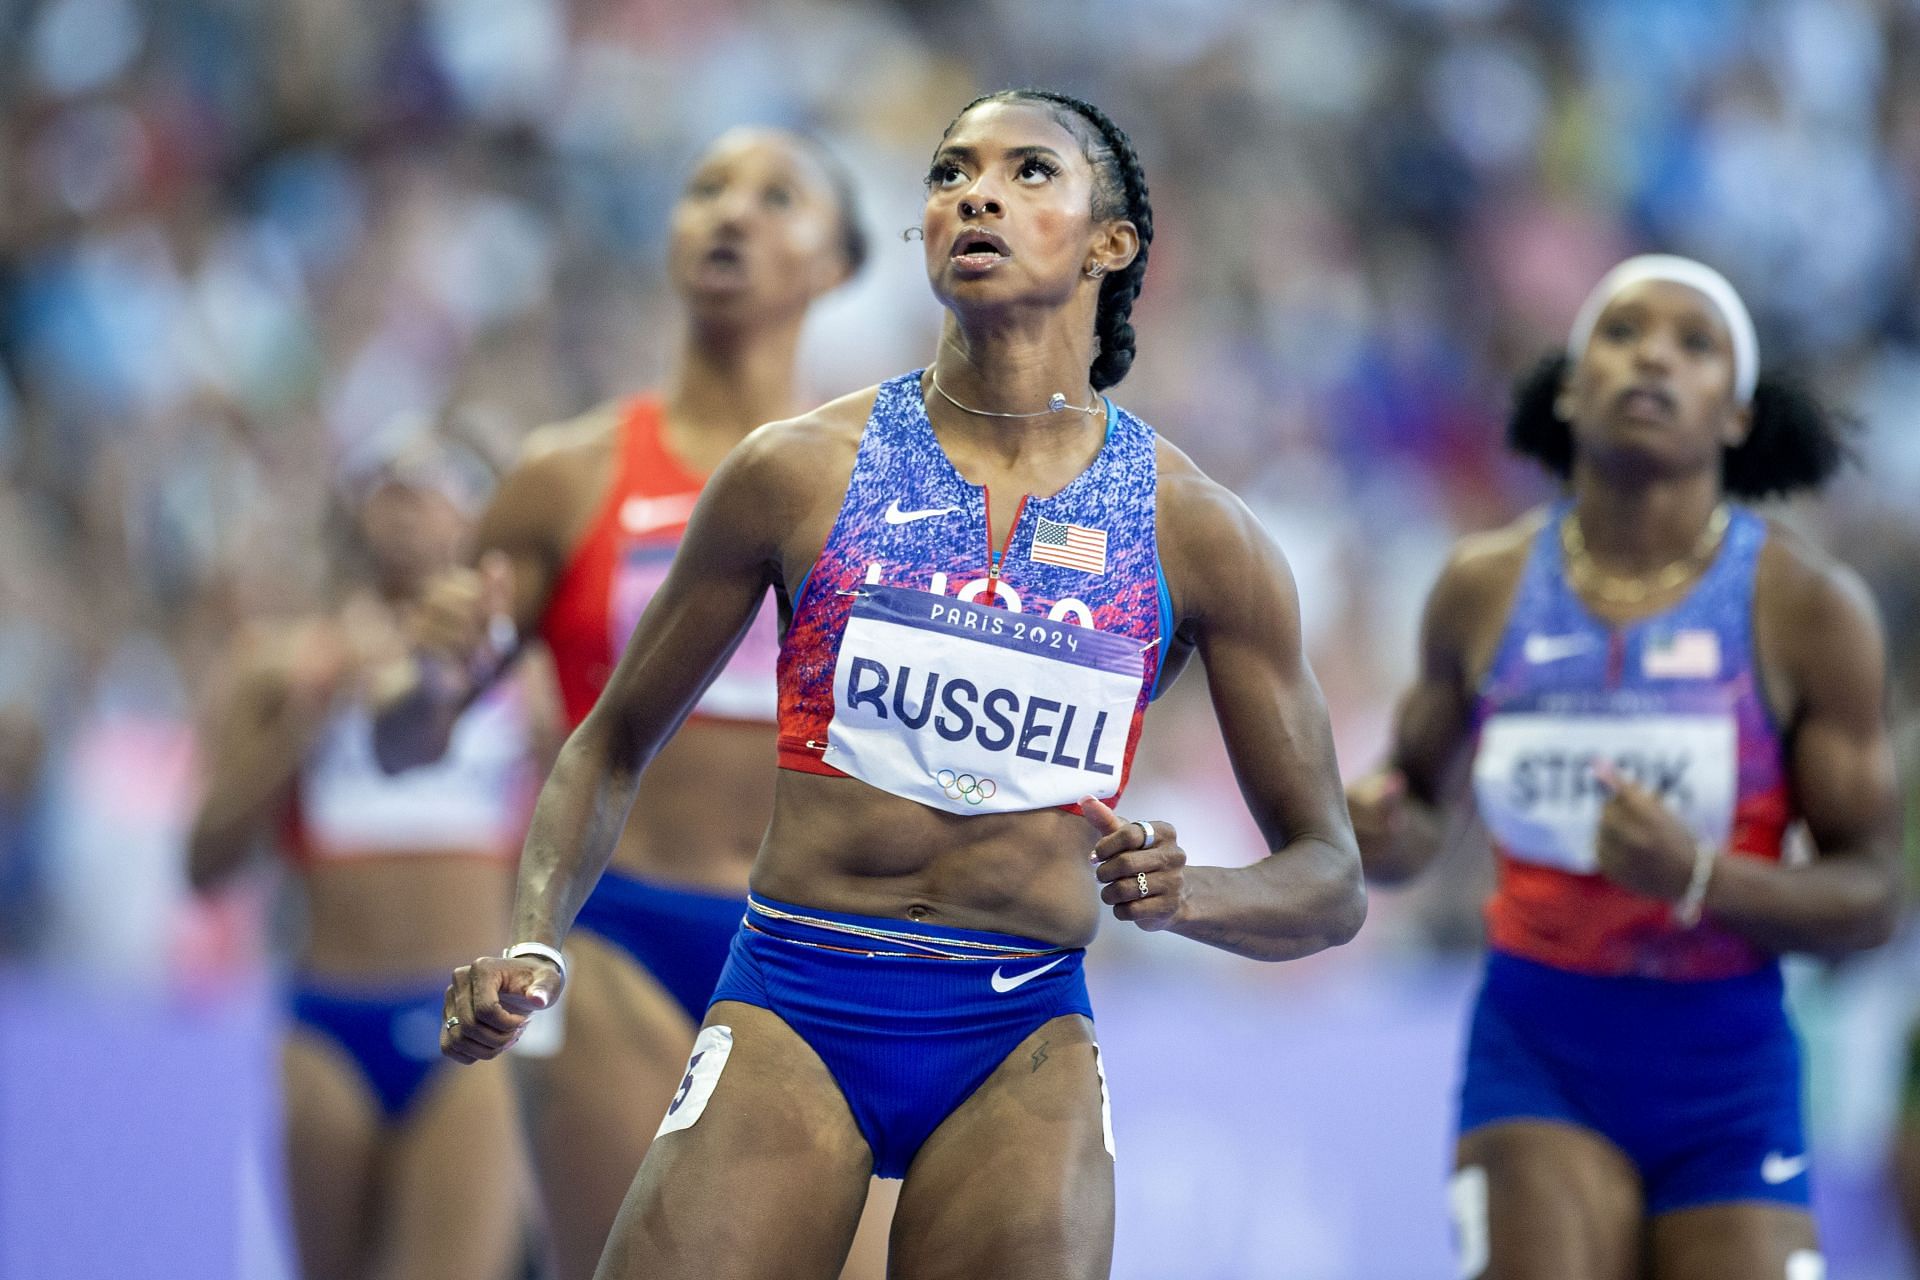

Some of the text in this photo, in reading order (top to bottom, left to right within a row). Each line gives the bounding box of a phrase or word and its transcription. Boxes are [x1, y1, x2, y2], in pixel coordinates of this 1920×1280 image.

[931, 603, 1079, 653] PARIS 2024
[847, 656, 1115, 776] RUSSELL
